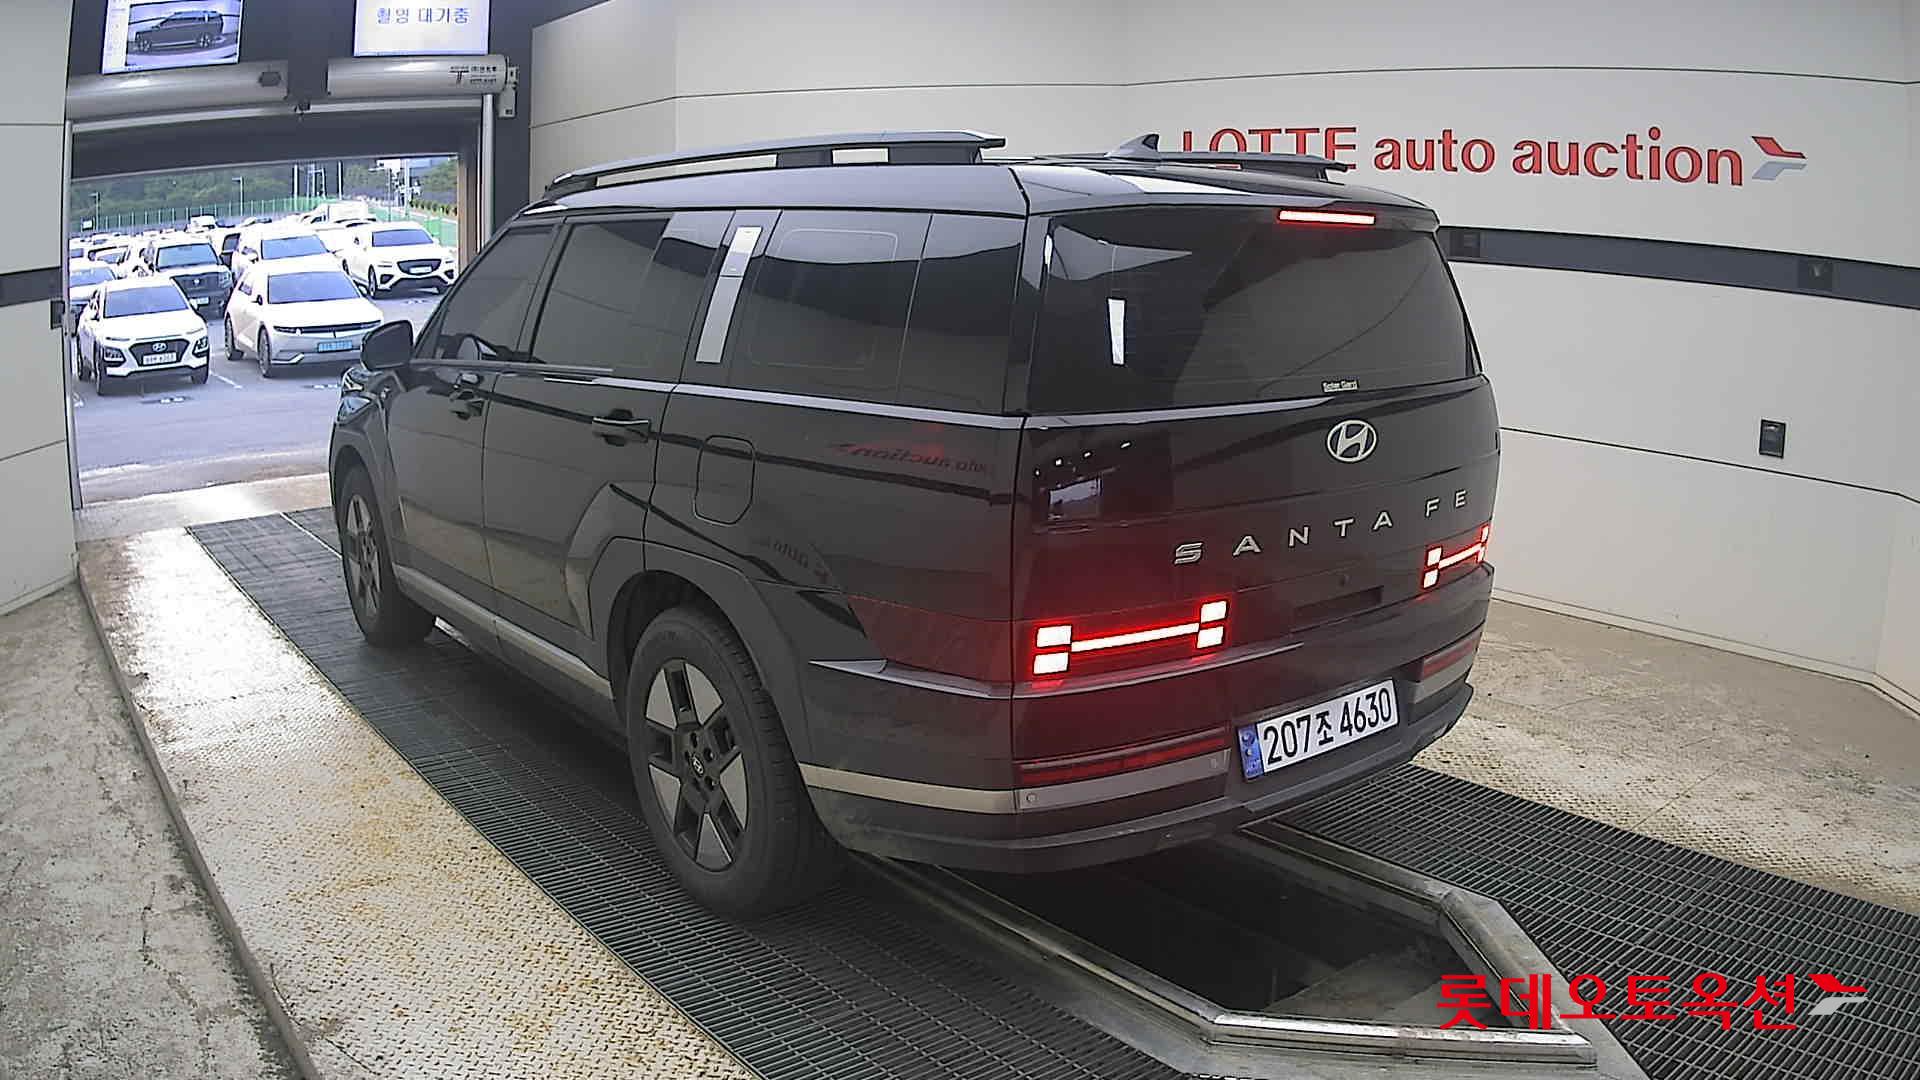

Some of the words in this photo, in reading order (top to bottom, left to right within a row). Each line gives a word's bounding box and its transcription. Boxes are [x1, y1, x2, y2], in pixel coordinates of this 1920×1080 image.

[418, 7, 469, 24] 대기중
[1373, 129, 1496, 172] auto
[1511, 126, 1744, 187] auction
[1173, 510, 1394, 566] SANTA
[1424, 489, 1468, 518] FE
[1263, 710, 1334, 766] 207조
[1339, 687, 1392, 737] 4630
